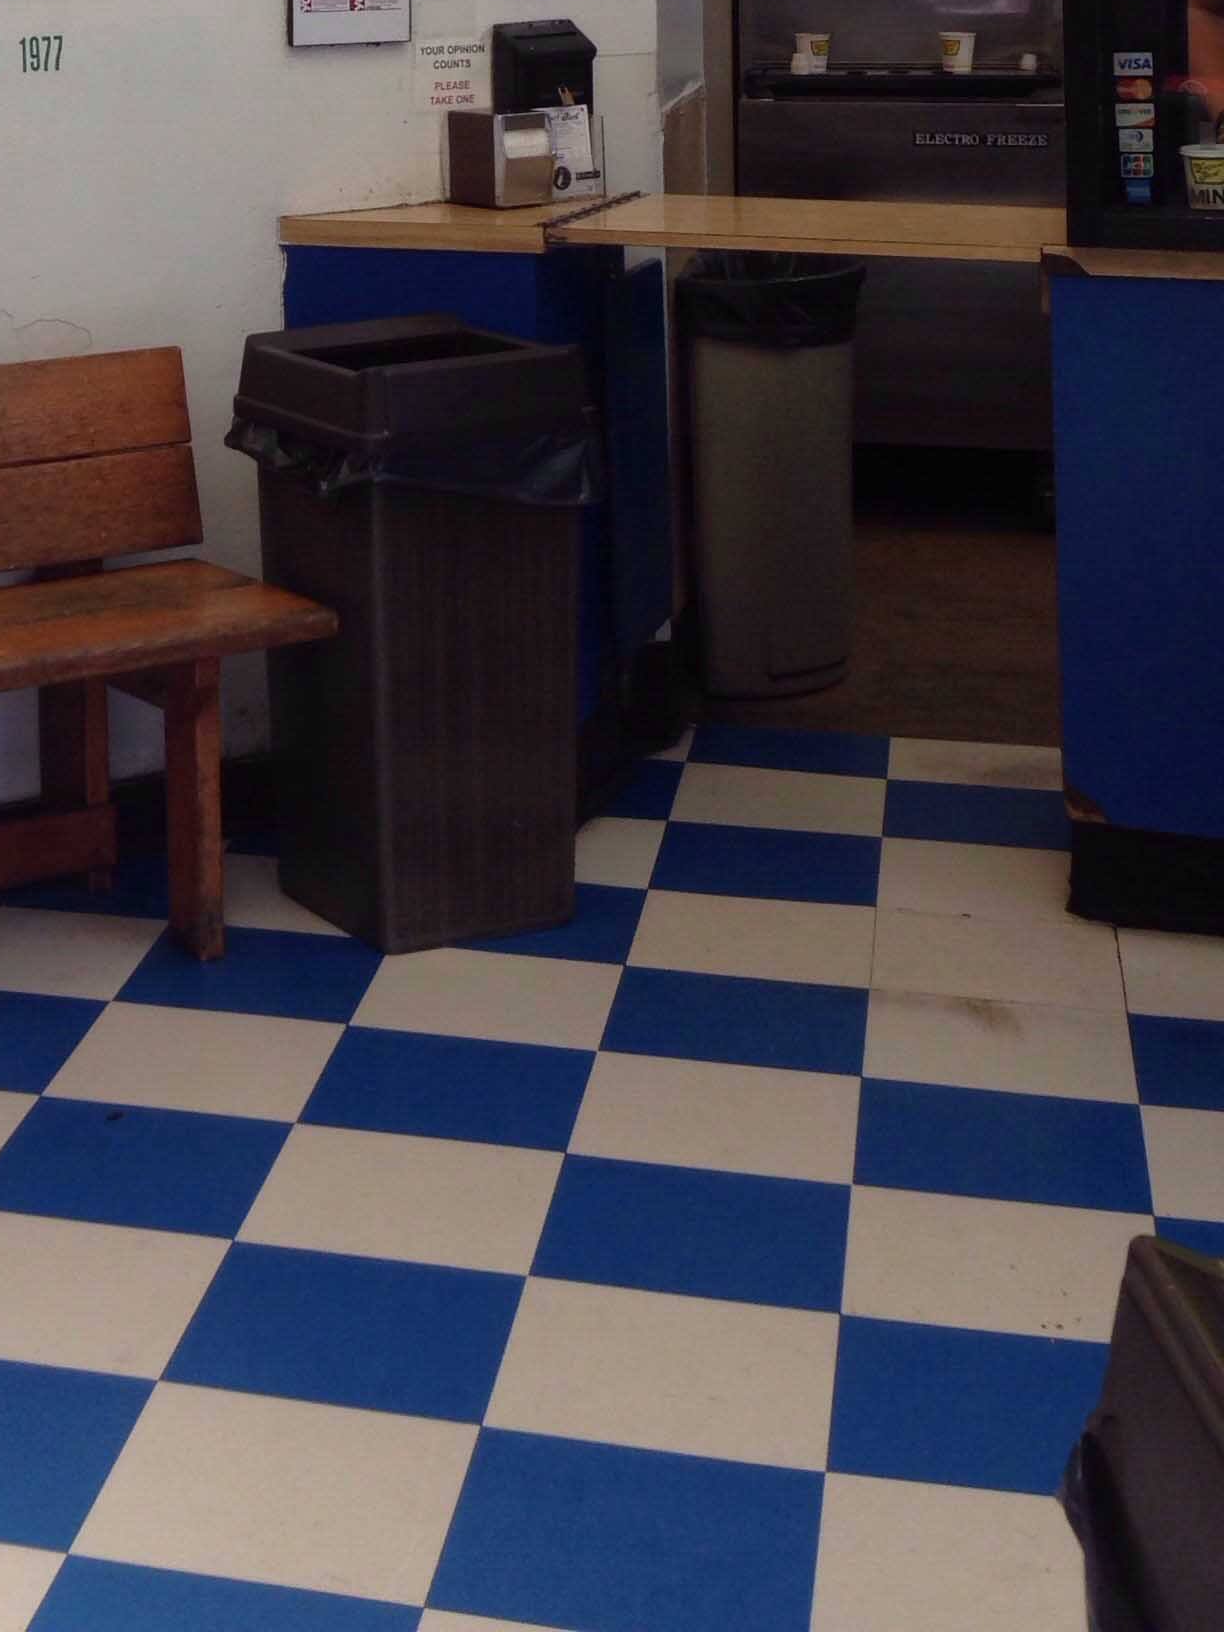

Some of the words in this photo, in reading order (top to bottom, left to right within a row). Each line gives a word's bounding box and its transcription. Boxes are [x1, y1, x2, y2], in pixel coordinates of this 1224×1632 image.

[19, 34, 64, 73] 1977
[420, 47, 445, 56] YOUR
[447, 44, 485, 54] OPINION
[433, 59, 471, 69] COUNTS
[1119, 59, 1152, 69] VISA
[435, 80, 470, 90] PLEASE
[430, 96, 454, 105] TAKE
[456, 94, 475, 104] ONE
[914, 132, 980, 146] ELECTRO
[987, 133, 1048, 147] FREEZE
